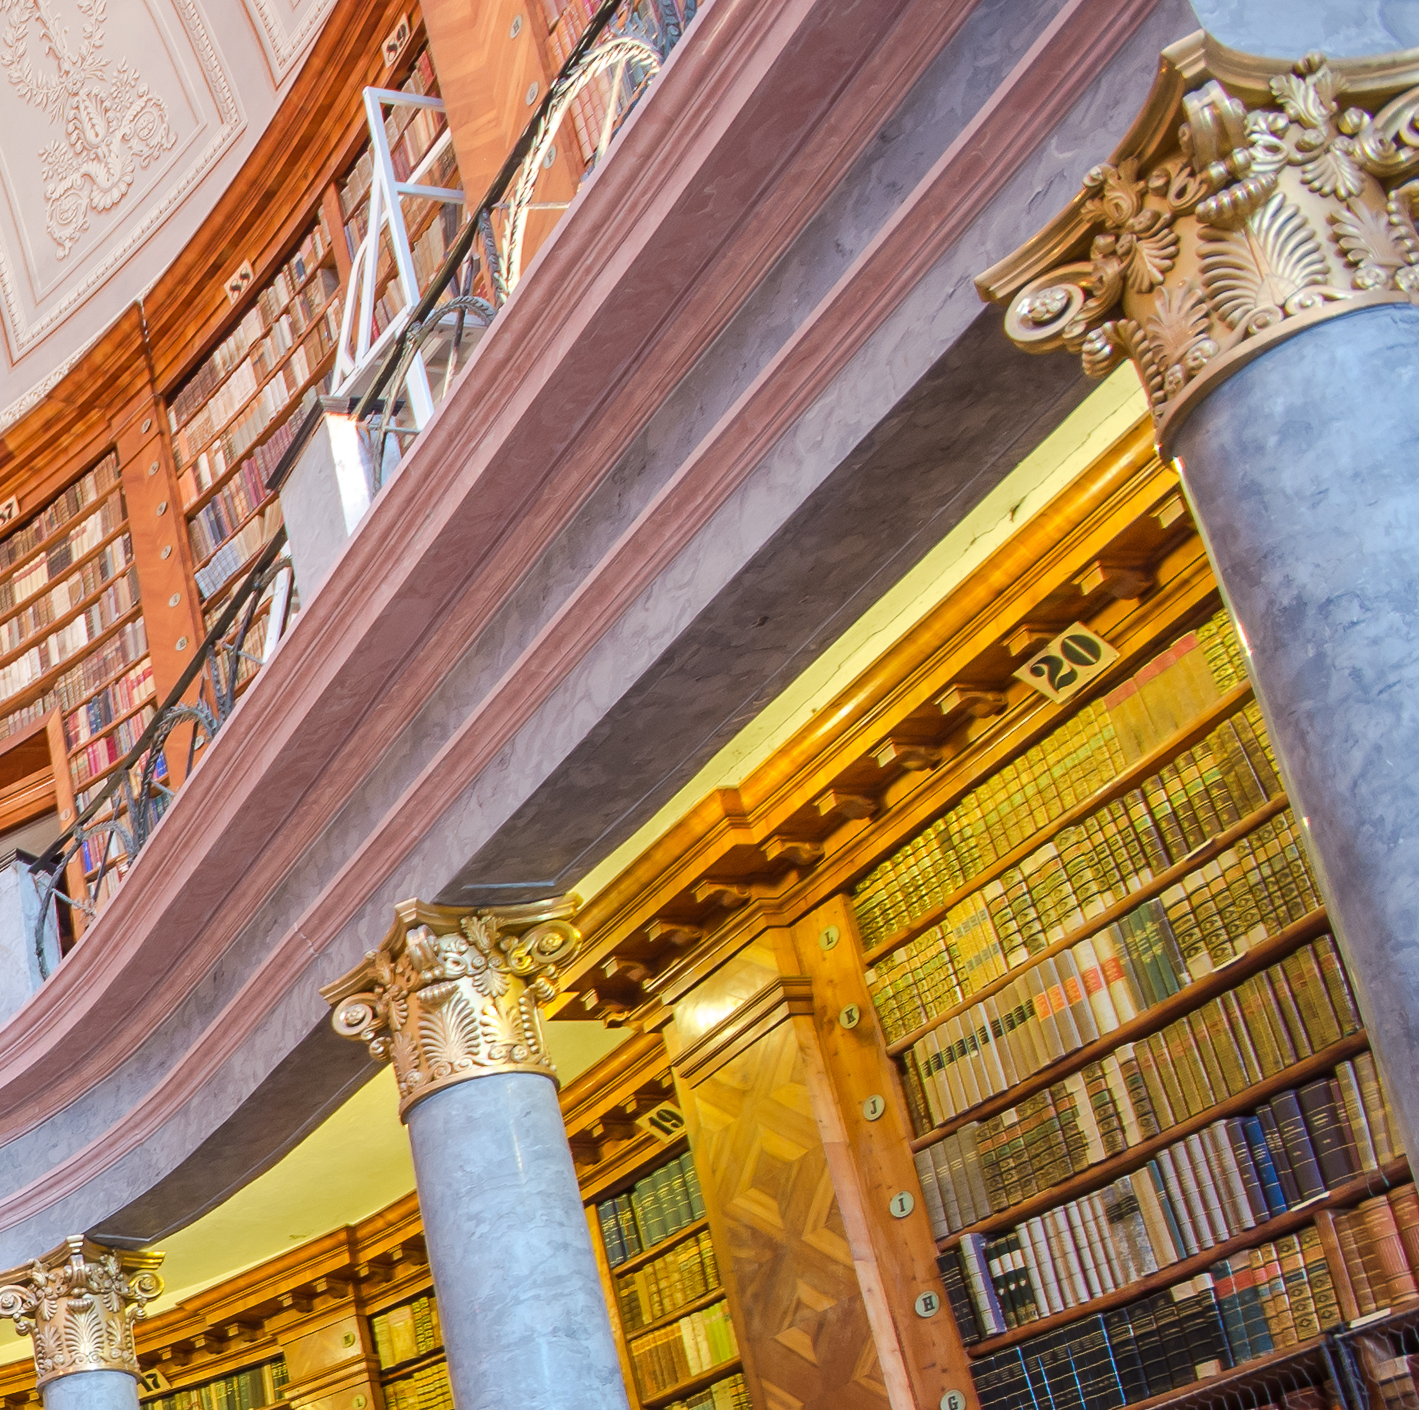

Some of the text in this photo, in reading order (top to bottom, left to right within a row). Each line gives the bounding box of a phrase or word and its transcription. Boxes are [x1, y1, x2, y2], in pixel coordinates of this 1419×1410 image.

[386, 24, 409, 62] 89
[1031, 633, 1102, 691] 20
[825, 931, 834, 946] L
[844, 1008, 857, 1024] K
[870, 1099, 877, 1115] J
[647, 1108, 685, 1137] 19
[898, 1197, 906, 1212] I
[922, 1295, 935, 1312] H
[947, 1396, 959, 1410] G
